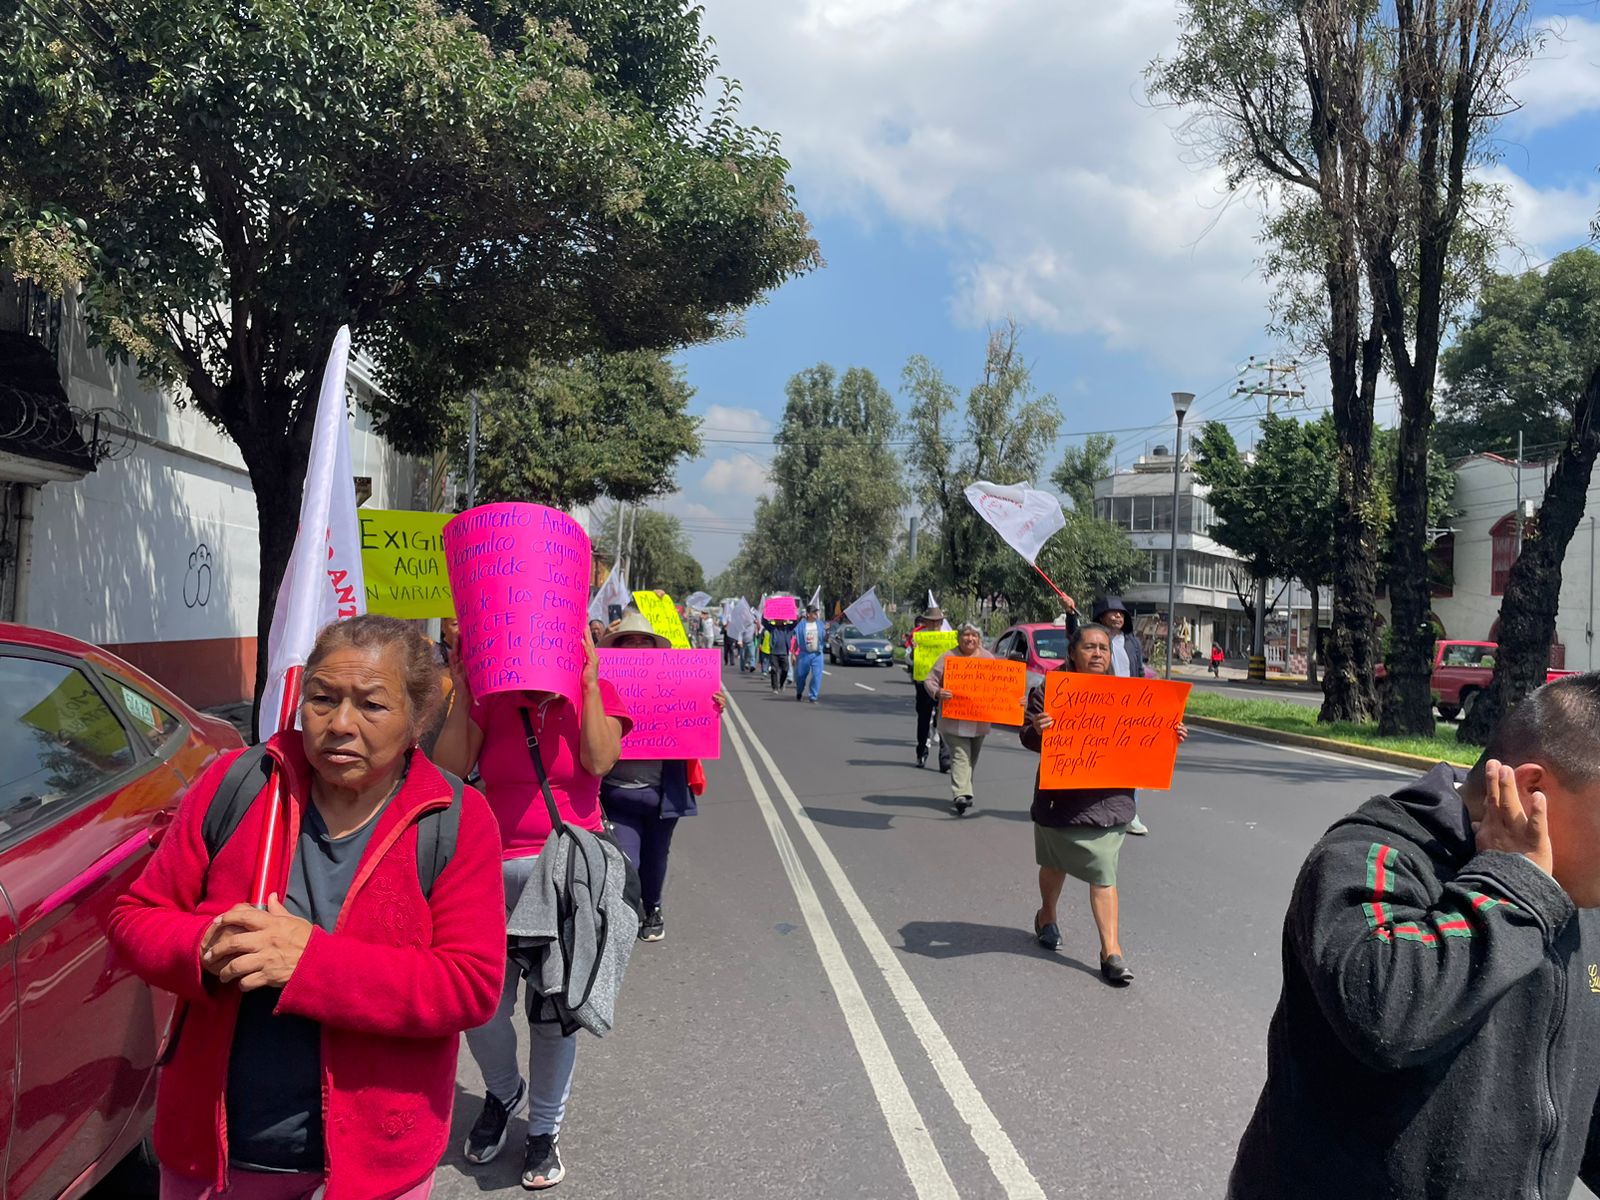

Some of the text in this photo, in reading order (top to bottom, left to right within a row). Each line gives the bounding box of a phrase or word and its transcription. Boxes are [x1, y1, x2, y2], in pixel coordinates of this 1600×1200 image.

[360, 519, 444, 552] EXIGI
[394, 556, 439, 579] AGUA
[366, 584, 452, 600] N VARIAS
[508, 586, 532, 605] los
[484, 611, 516, 631] CFE
[508, 632, 521, 650] la
[530, 631, 564, 651] obra
[530, 649, 548, 667] la
[599, 652, 654, 667] ovimiento
[616, 683, 647, 698] lcalde
[1051, 678, 1153, 718] Exigimos a la
[1044, 735, 1074, 751] agua
[1080, 734, 1109, 756] para
[1116, 729, 1130, 747] la
